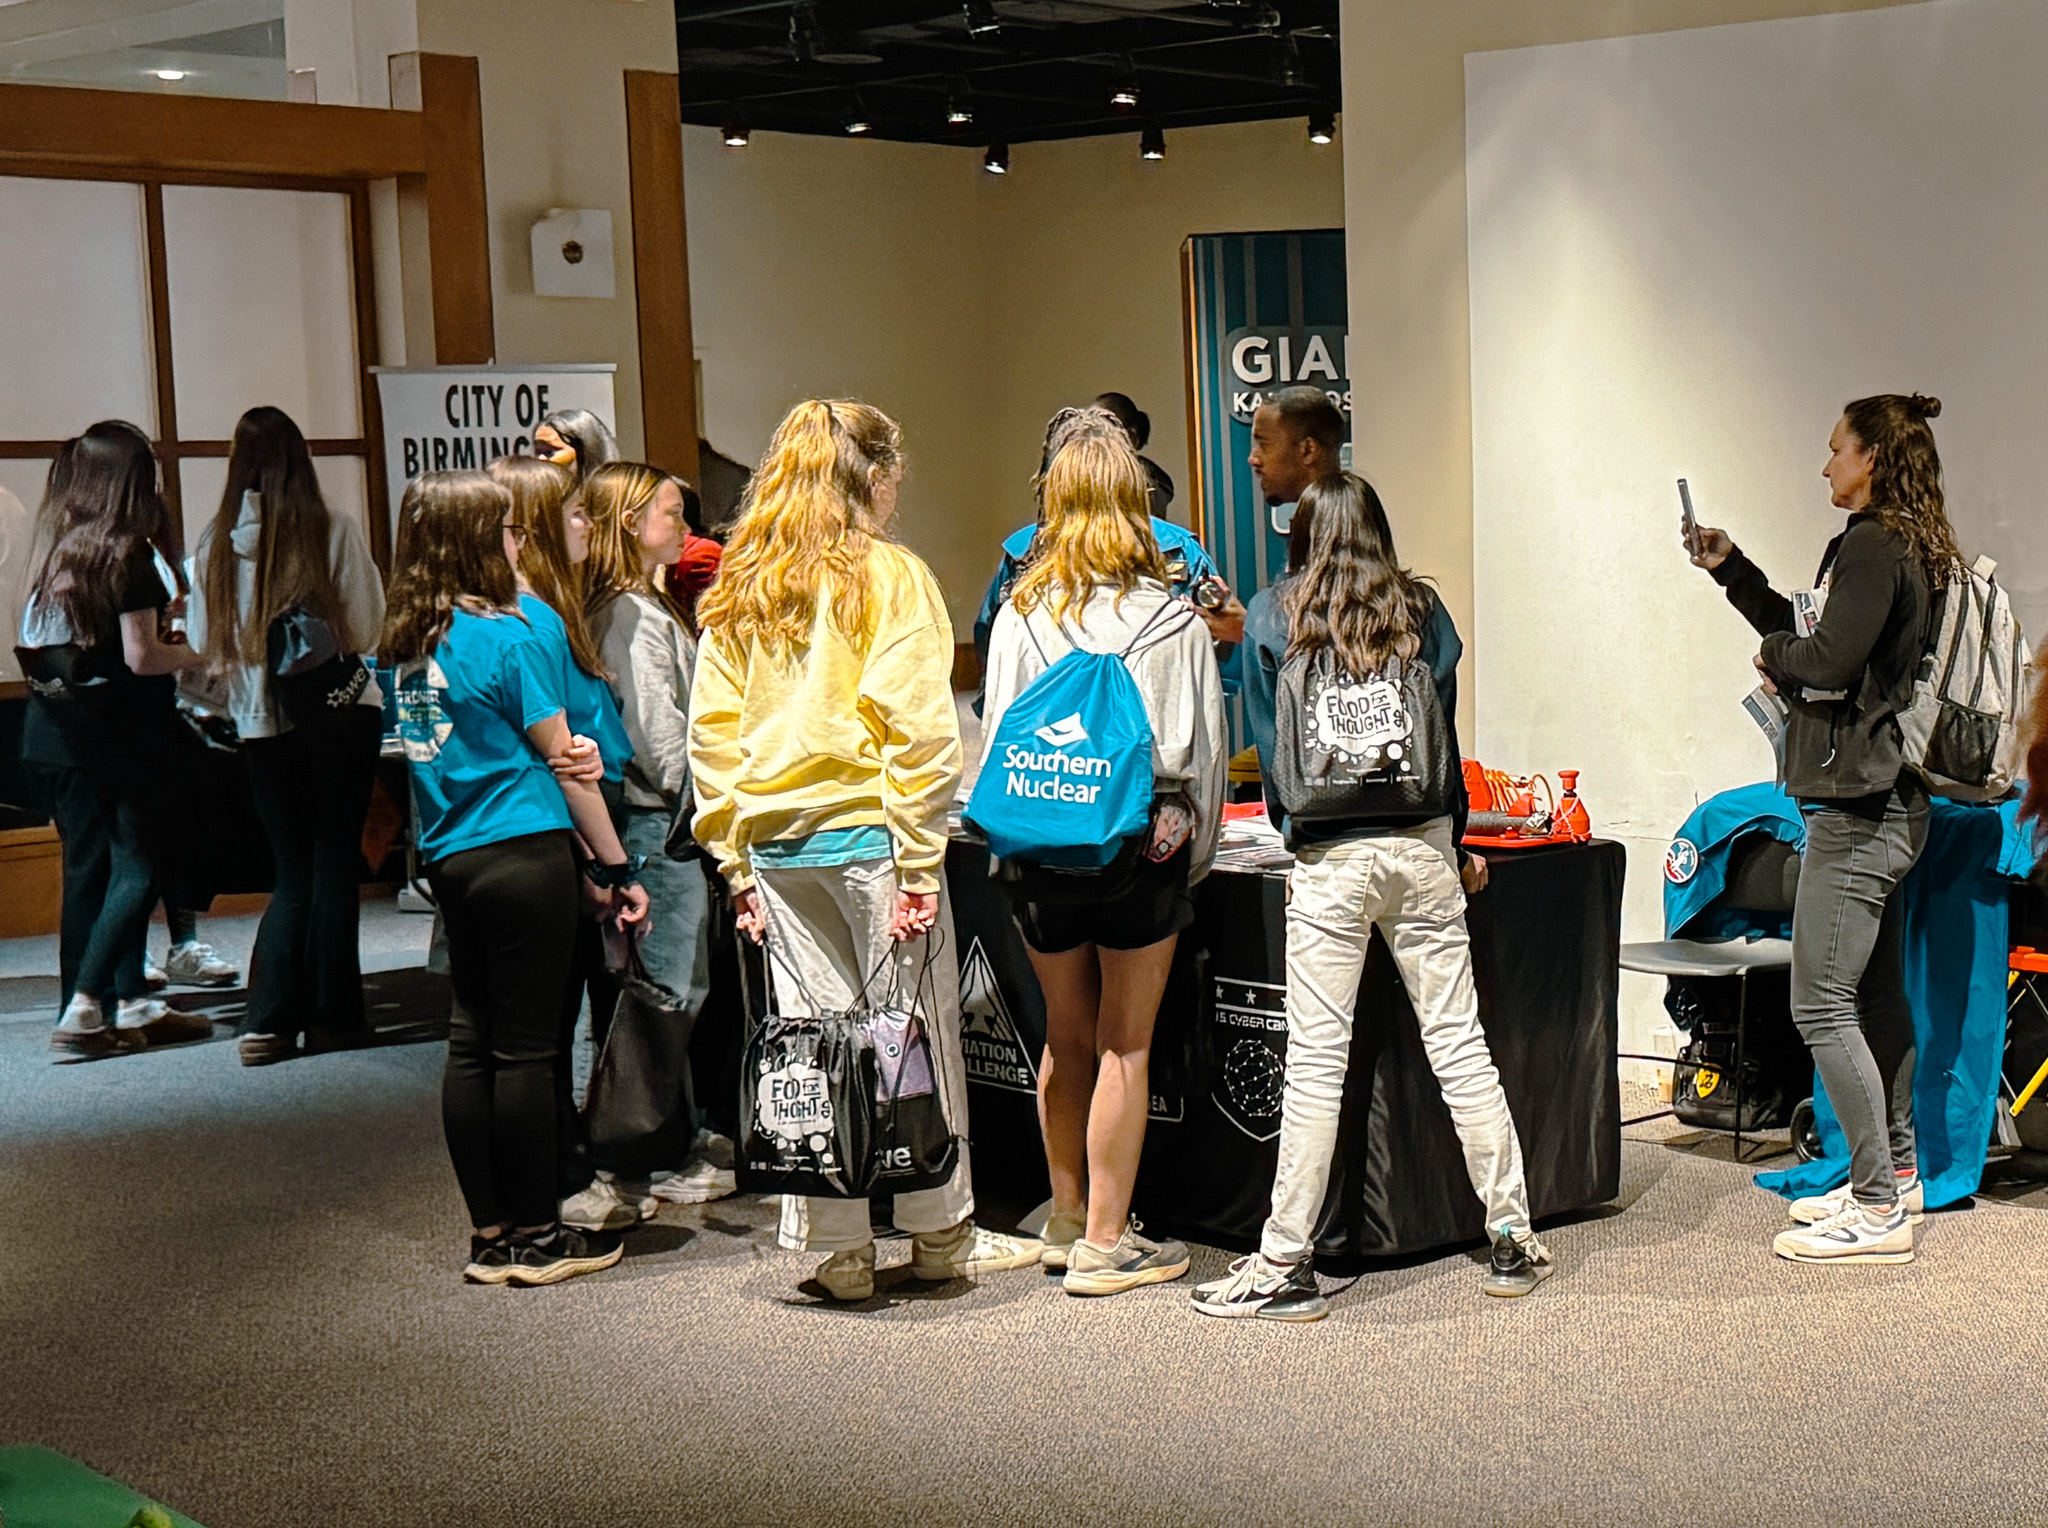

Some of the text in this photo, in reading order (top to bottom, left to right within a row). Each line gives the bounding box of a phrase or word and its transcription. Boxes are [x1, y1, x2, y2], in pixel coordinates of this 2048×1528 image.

[445, 383, 550, 429] CITY OF
[1326, 695, 1370, 718] FOOD
[1328, 707, 1391, 735] THOUGHT
[1002, 745, 1112, 778] Southern
[1006, 771, 1102, 804] Nuclear
